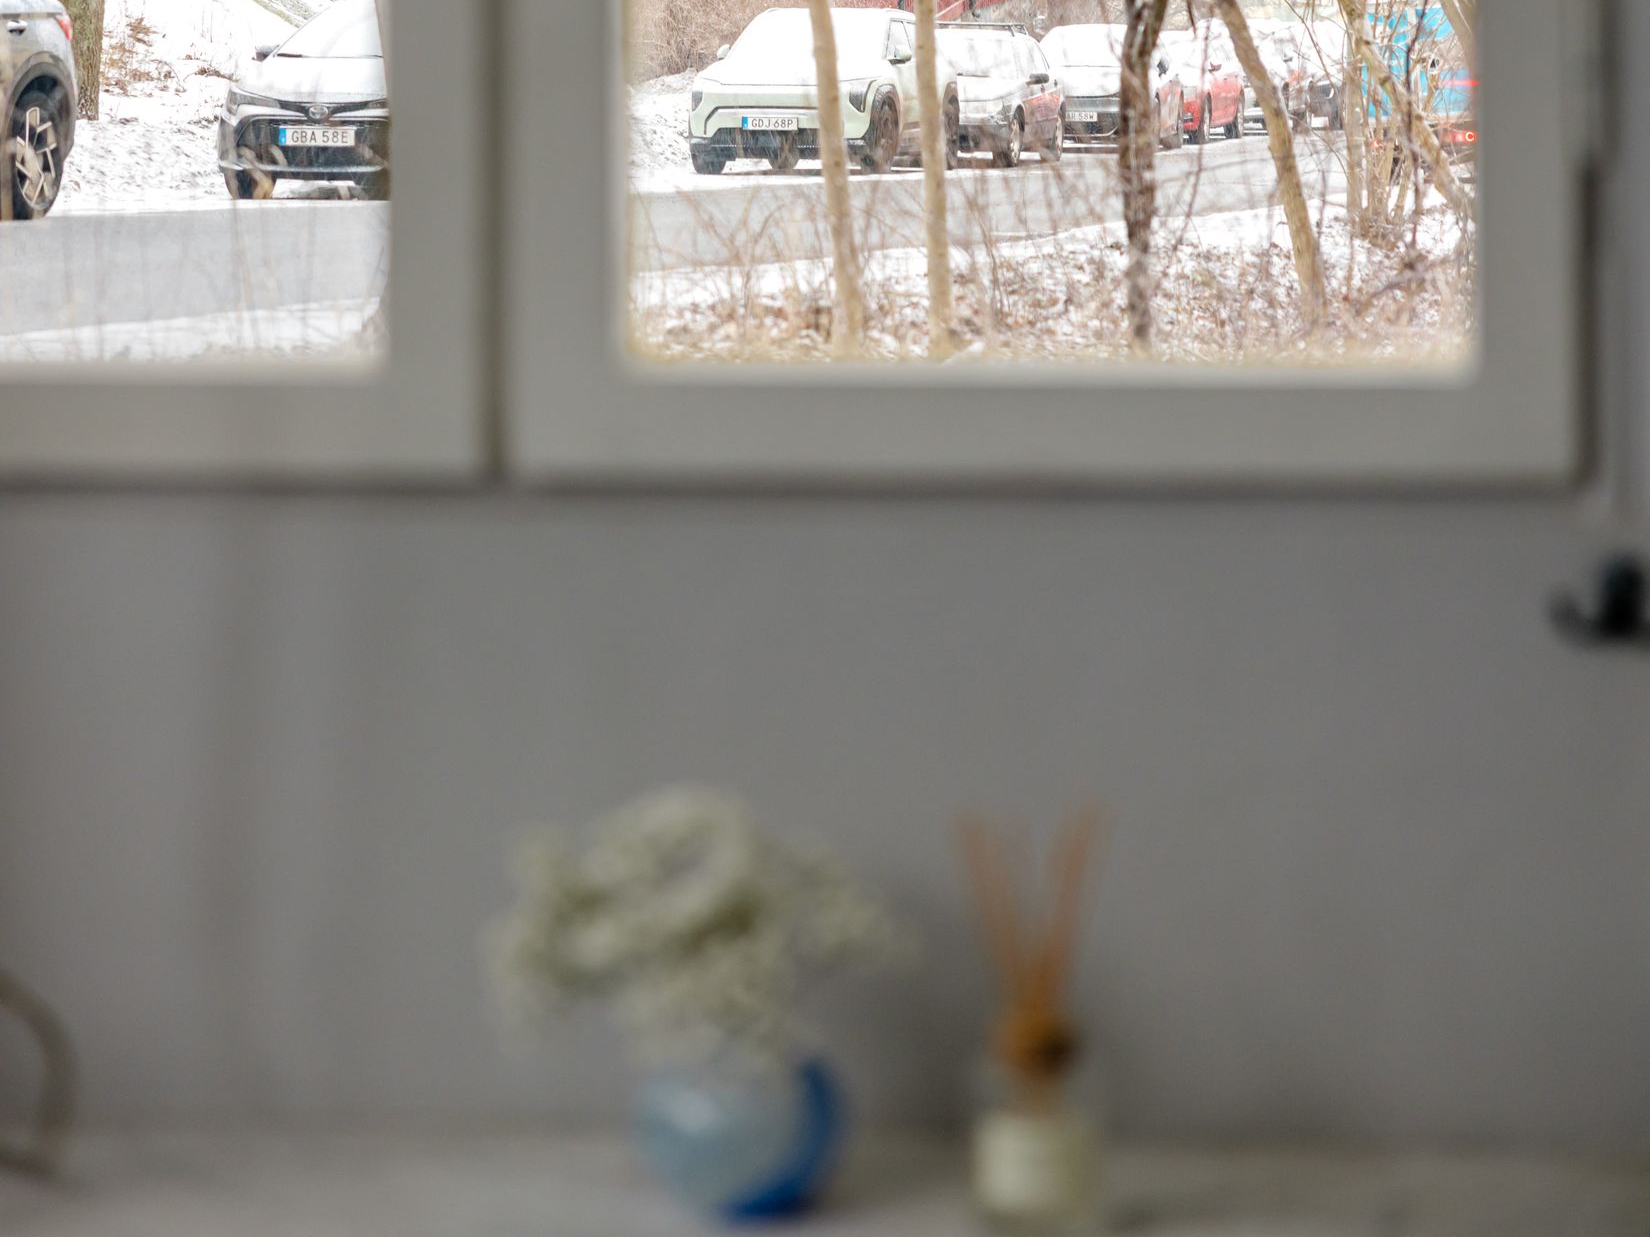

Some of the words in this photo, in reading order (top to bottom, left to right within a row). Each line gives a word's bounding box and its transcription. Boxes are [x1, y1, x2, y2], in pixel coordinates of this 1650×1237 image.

[751, 118, 770, 128] GDJ
[773, 118, 793, 128] 68P
[291, 130, 317, 143] GBA
[322, 130, 349, 143] 58E
